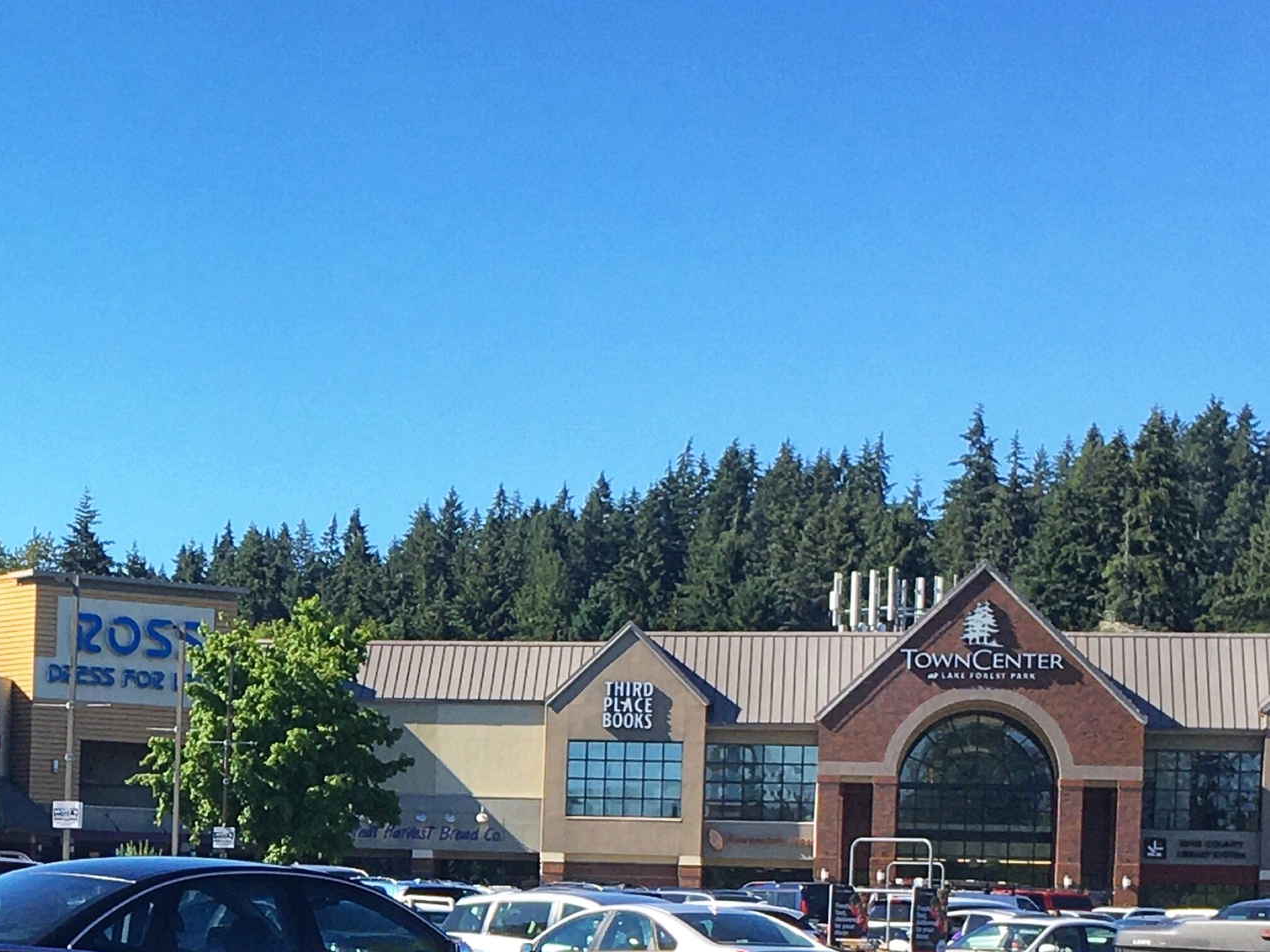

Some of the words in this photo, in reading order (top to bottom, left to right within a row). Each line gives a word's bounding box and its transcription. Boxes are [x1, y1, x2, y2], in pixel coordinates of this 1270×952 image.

[121, 668, 165, 691] FOR
[941, 672, 965, 680] LAKE
[969, 672, 1006, 680] FOREST
[1010, 672, 1036, 680] PARK
[604, 681, 654, 698] THIRD
[603, 697, 653, 713] PLACE
[602, 712, 653, 730] BOOKS
[439, 826, 479, 842] Bread
